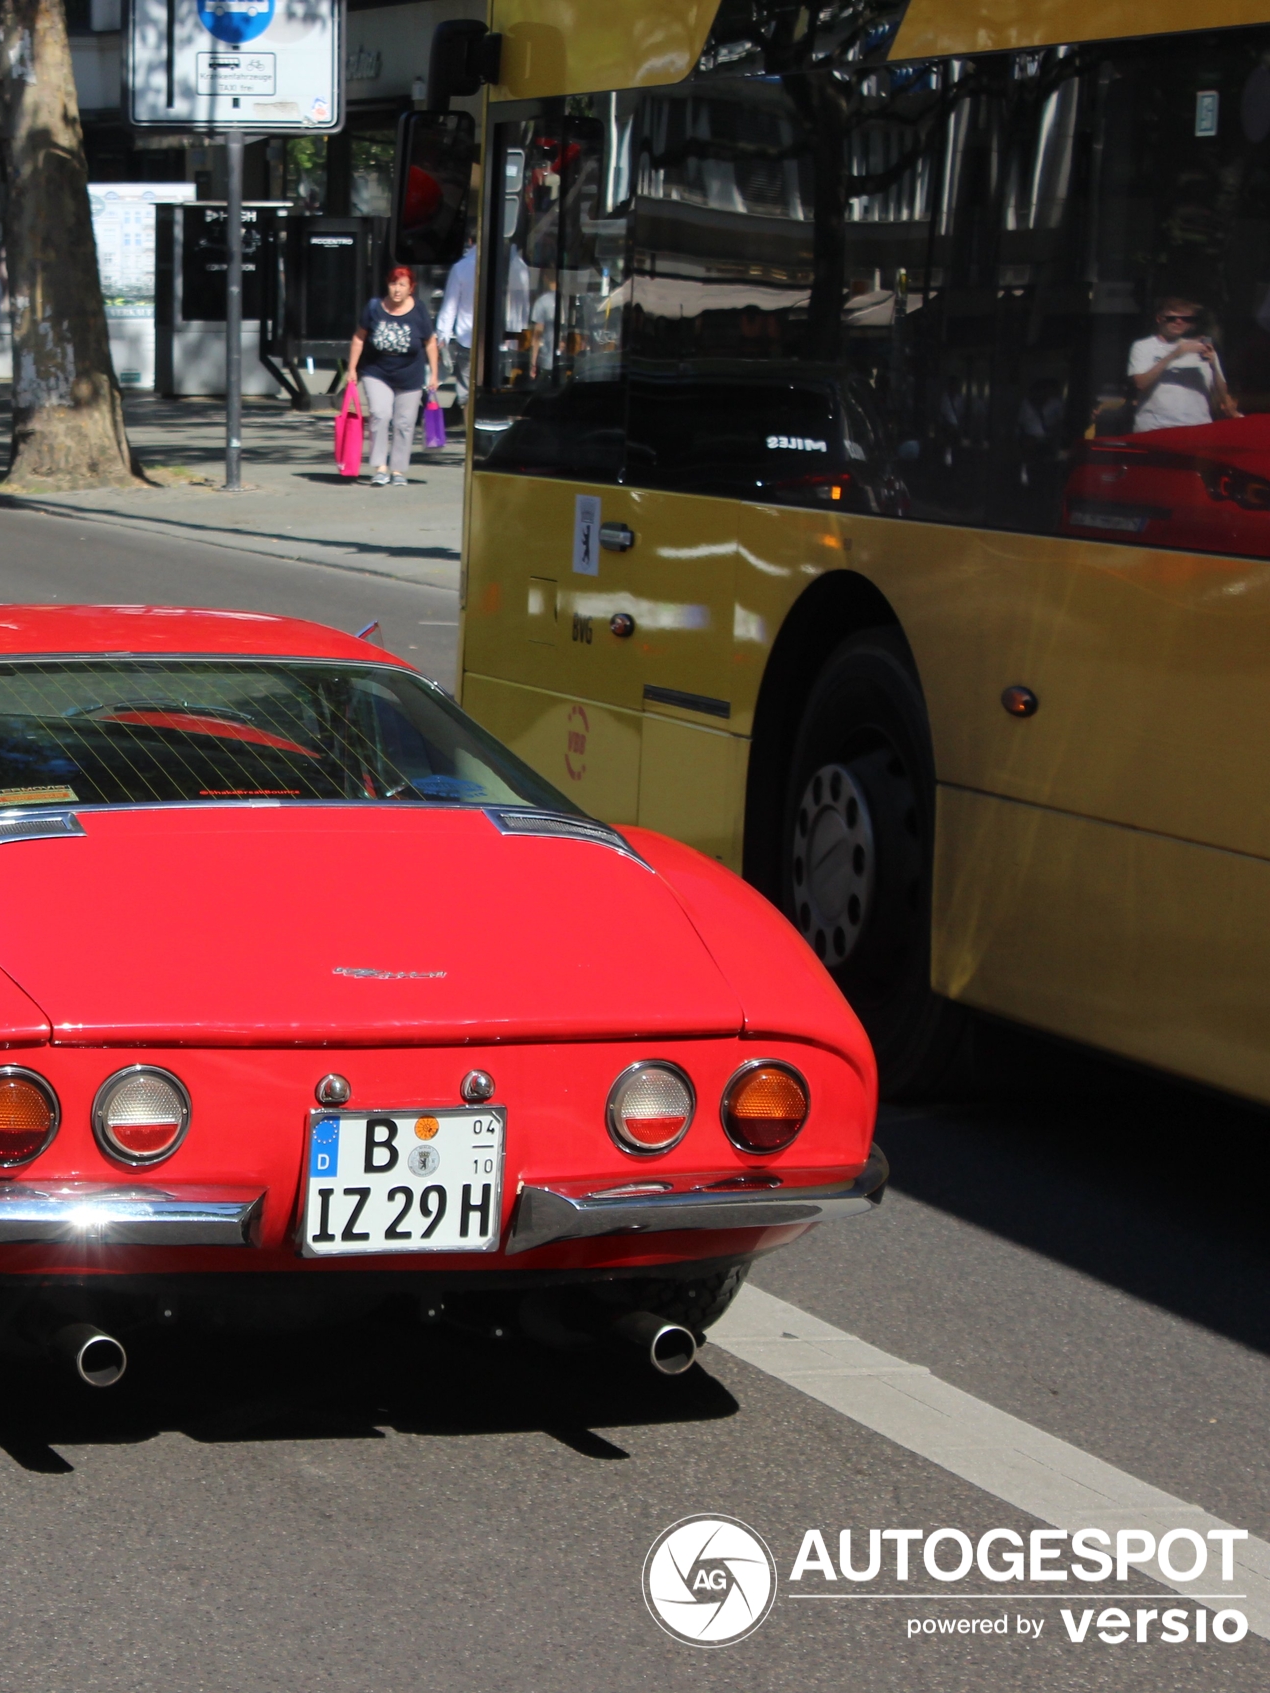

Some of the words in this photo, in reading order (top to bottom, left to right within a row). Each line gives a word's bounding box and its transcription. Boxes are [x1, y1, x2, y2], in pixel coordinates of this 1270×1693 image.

[200, 72, 273, 82] Krankenfahrzeuge
[219, 84, 237, 92] TAXI
[239, 84, 254, 92] frei
[473, 1119, 496, 1135] 04
[364, 1118, 399, 1174] B
[317, 1154, 330, 1170] D
[473, 1158, 494, 1174] 10
[311, 1187, 371, 1243] IZ
